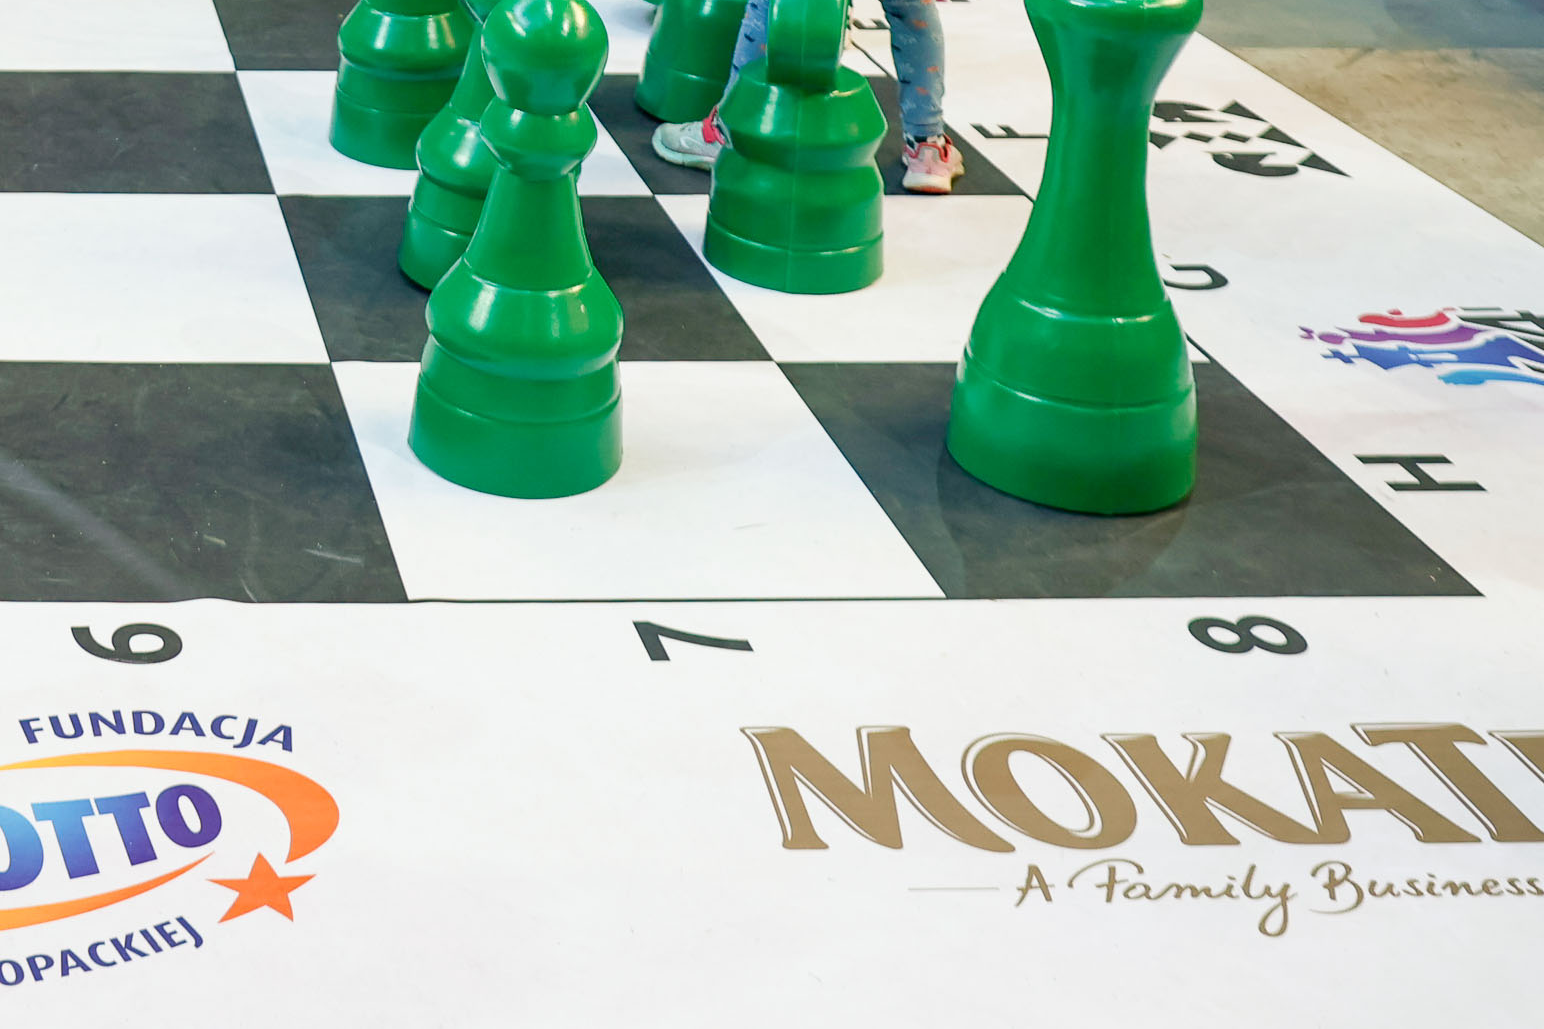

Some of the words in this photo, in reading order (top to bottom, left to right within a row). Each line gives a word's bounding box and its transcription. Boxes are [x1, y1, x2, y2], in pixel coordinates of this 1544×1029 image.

[1354, 455, 1487, 492] H
[71, 622, 183, 664] 6
[632, 621, 753, 661] 7
[1188, 616, 1308, 655] 8
[18, 710, 294, 753] FUNDACJA
[1015, 864, 1055, 908] A
[1067, 859, 1298, 937] Family
[1309, 860, 1544, 914] Business
